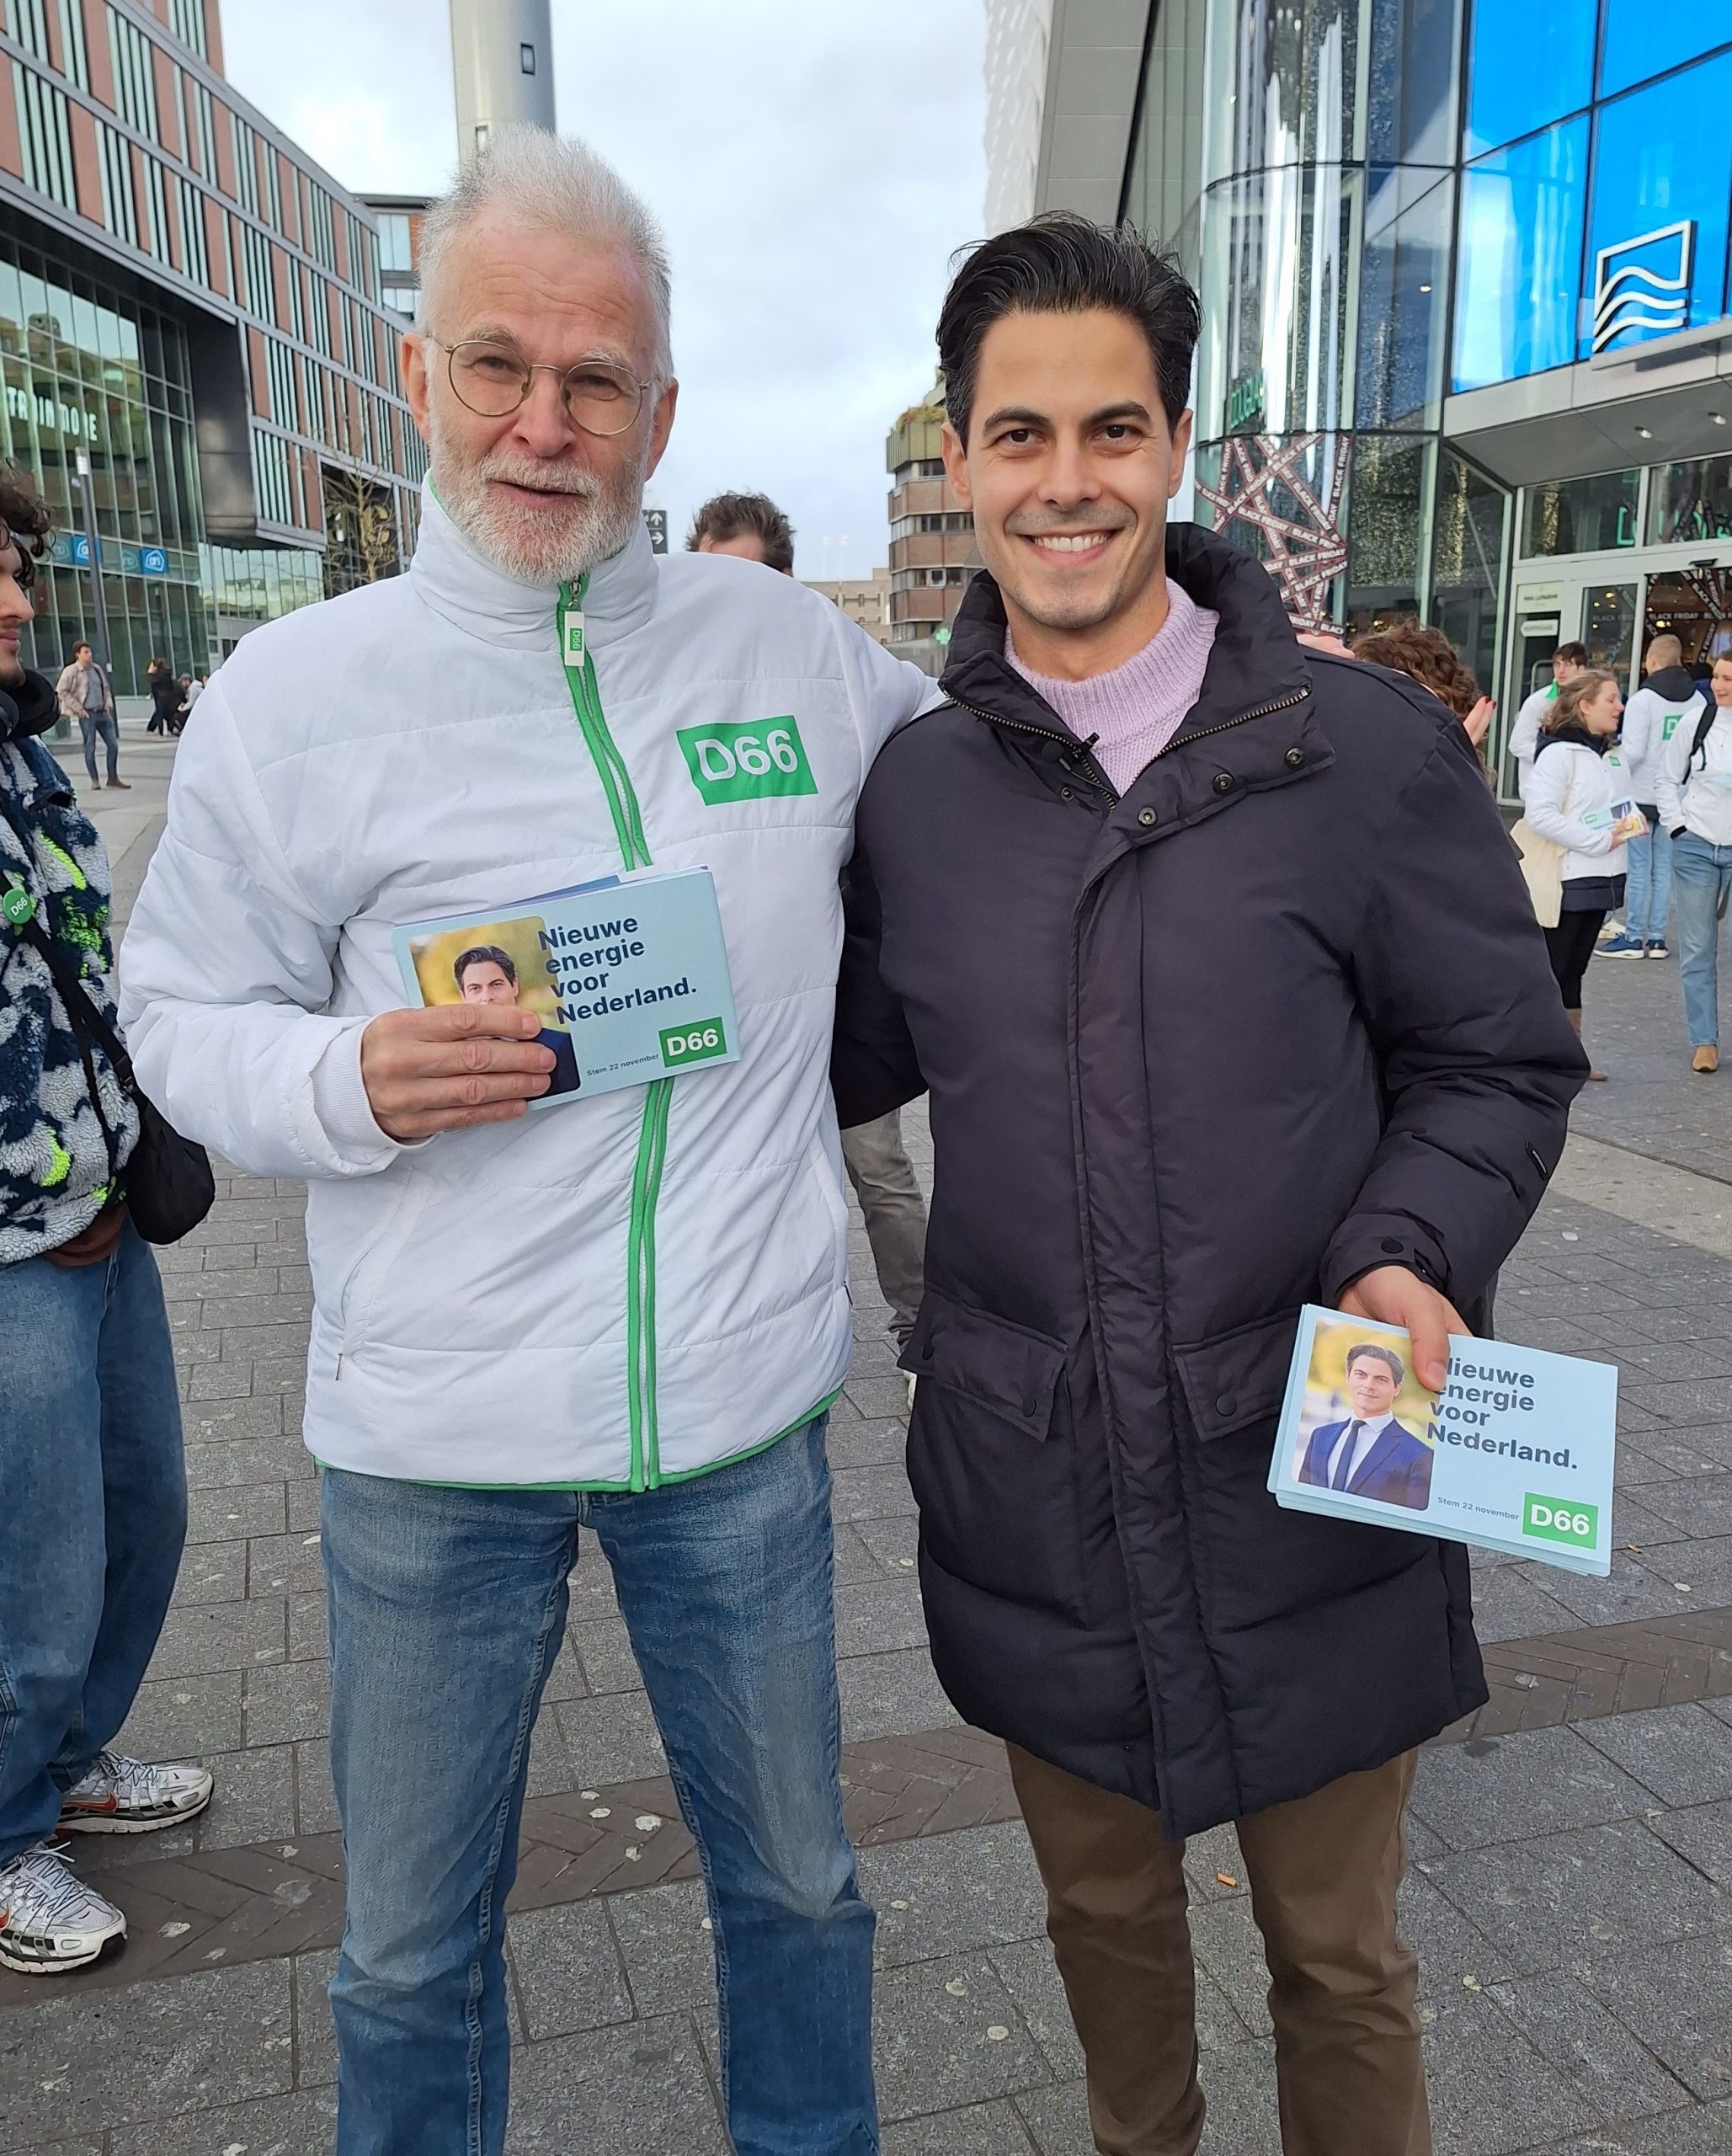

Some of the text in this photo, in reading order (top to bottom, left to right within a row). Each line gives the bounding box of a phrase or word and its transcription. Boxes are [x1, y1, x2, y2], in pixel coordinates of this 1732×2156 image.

[1332, 436, 1350, 497] BLACK FRIDAY
[1293, 482, 1314, 505] BLACK
[1310, 505, 1332, 530] FRIDAY
[1292, 527, 1319, 544] BLACK
[1288, 555, 1316, 567] BLACK
[1317, 548, 1346, 560] FRIDAY
[1294, 561, 1348, 592] BLACK FRIDAY
[1320, 623, 1344, 635] BLAC
[695, 729, 798, 781] D66
[10, 897, 28, 916] D66
[538, 918, 638, 950] Nieuwe
[546, 938, 645, 974] energie
[550, 972, 610, 998] voor
[556, 977, 697, 1025] Nederland.
[666, 1028, 719, 1057] D66
[587, 1067, 607, 1076] Stem
[620, 1054, 659, 1067] november
[1431, 1401, 1491, 1427] voor
[1427, 1421, 1578, 1470] Nederland.
[1437, 1496, 1520, 1521] Stem 22 november
[1530, 1503, 1591, 1536] D66
